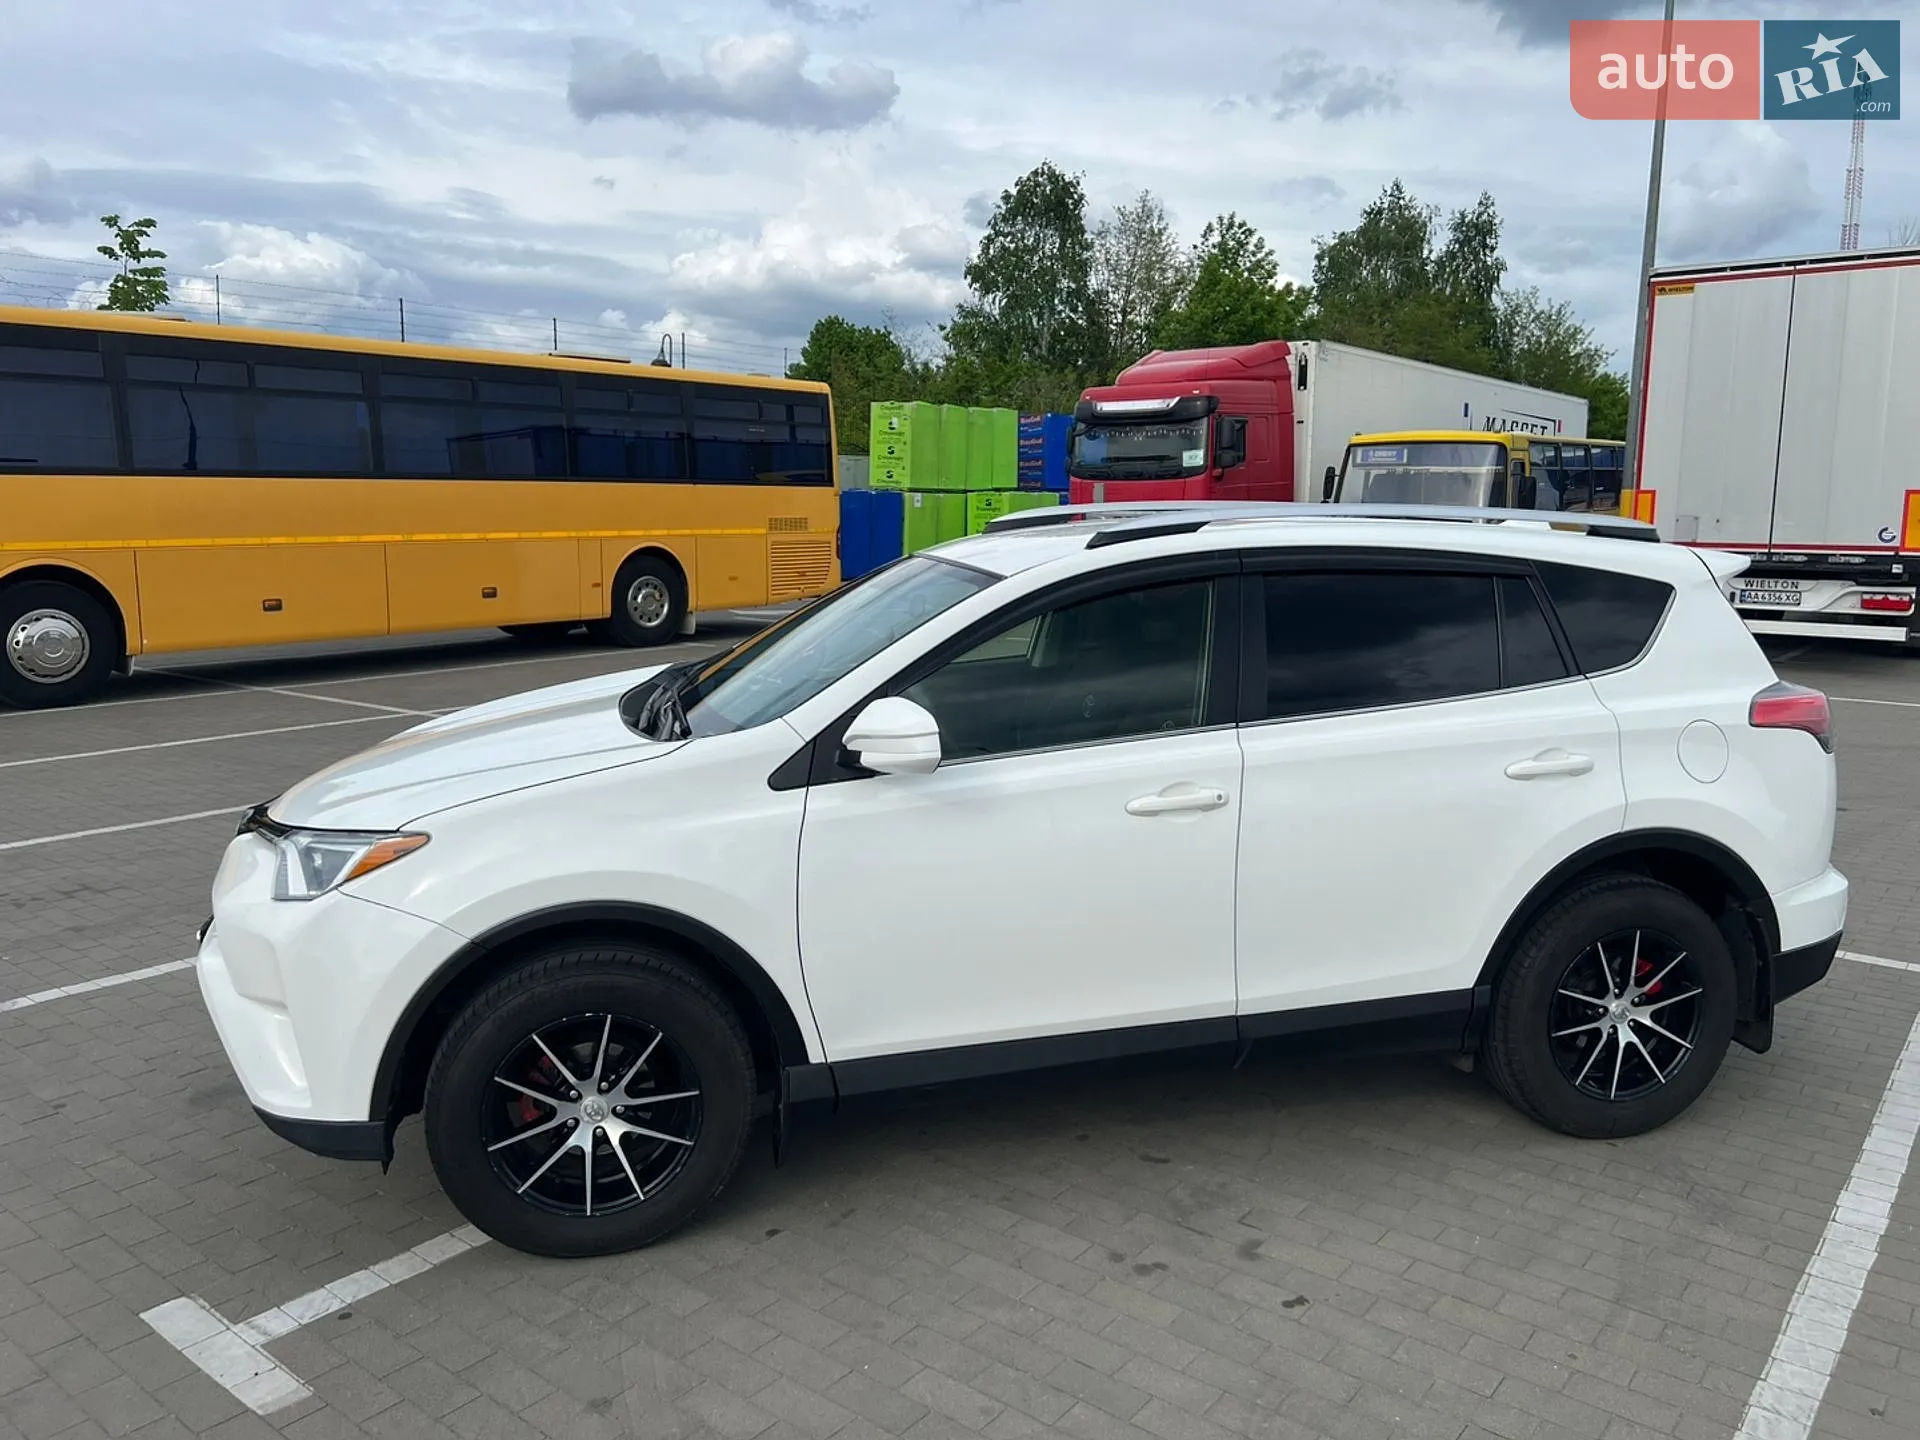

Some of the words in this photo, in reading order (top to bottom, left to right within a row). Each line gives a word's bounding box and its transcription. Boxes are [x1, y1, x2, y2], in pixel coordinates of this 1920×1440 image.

[1743, 579, 1800, 590] WIELTON
[1746, 591, 1760, 600] AA
[1761, 592, 1783, 601] 6356
